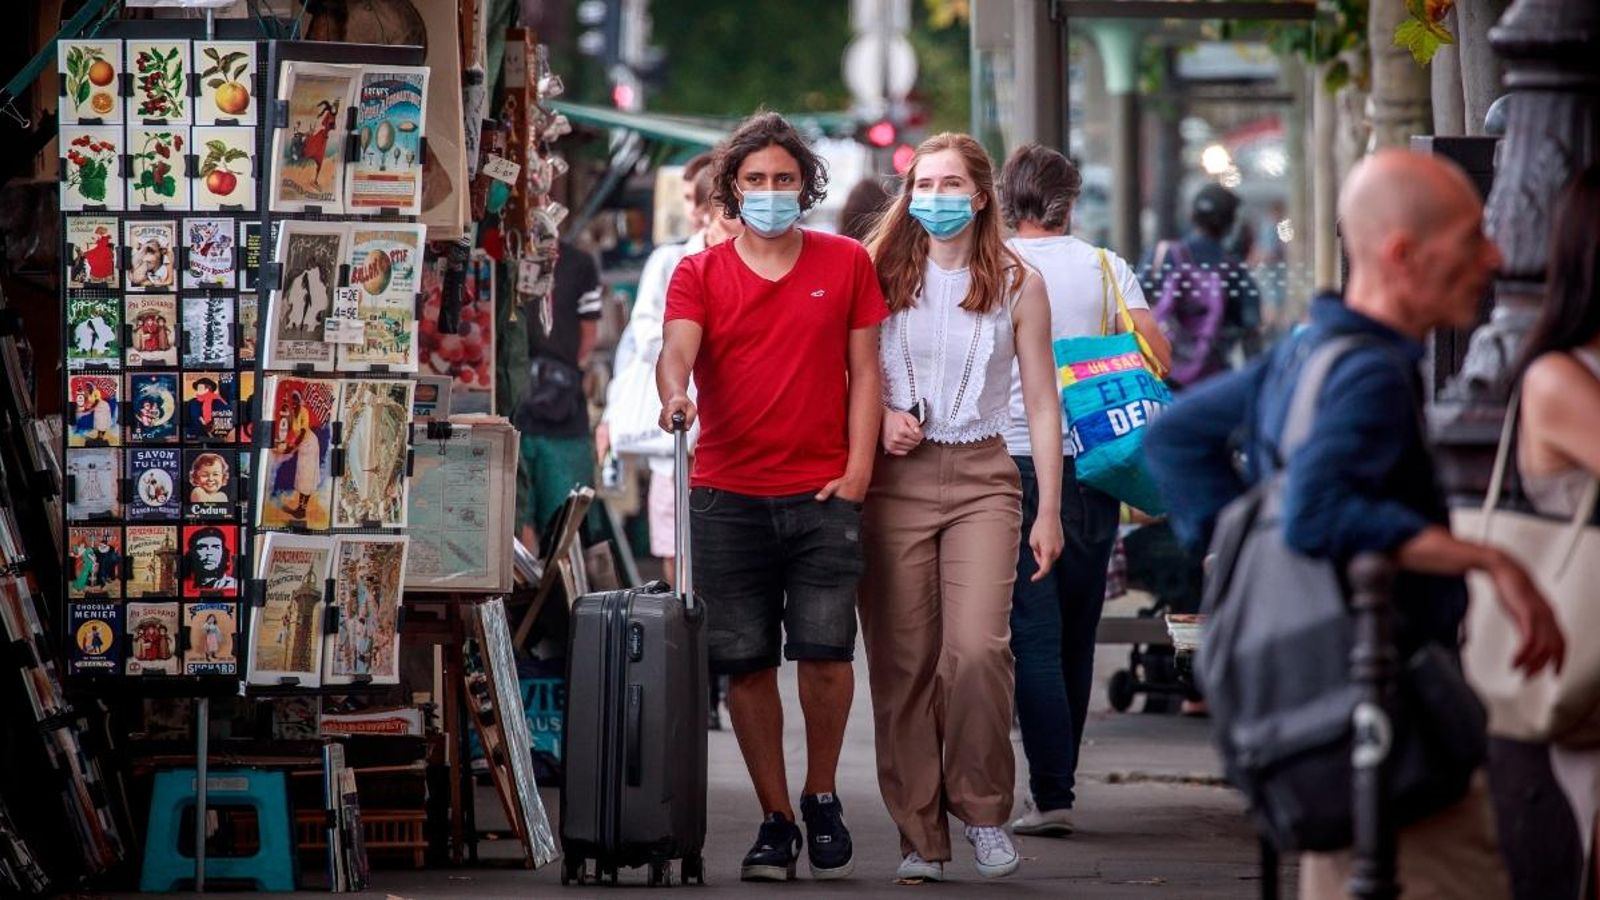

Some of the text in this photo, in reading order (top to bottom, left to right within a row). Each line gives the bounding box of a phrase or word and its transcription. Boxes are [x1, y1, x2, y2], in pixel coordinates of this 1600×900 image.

[335, 288, 358, 301] 1=2€
[1087, 354, 1141, 374] UN SAC
[1096, 378, 1128, 405] ET
[137, 450, 175, 460] SAVON
[191, 504, 228, 515] Cadum
[74, 611, 116, 619] MENIER
